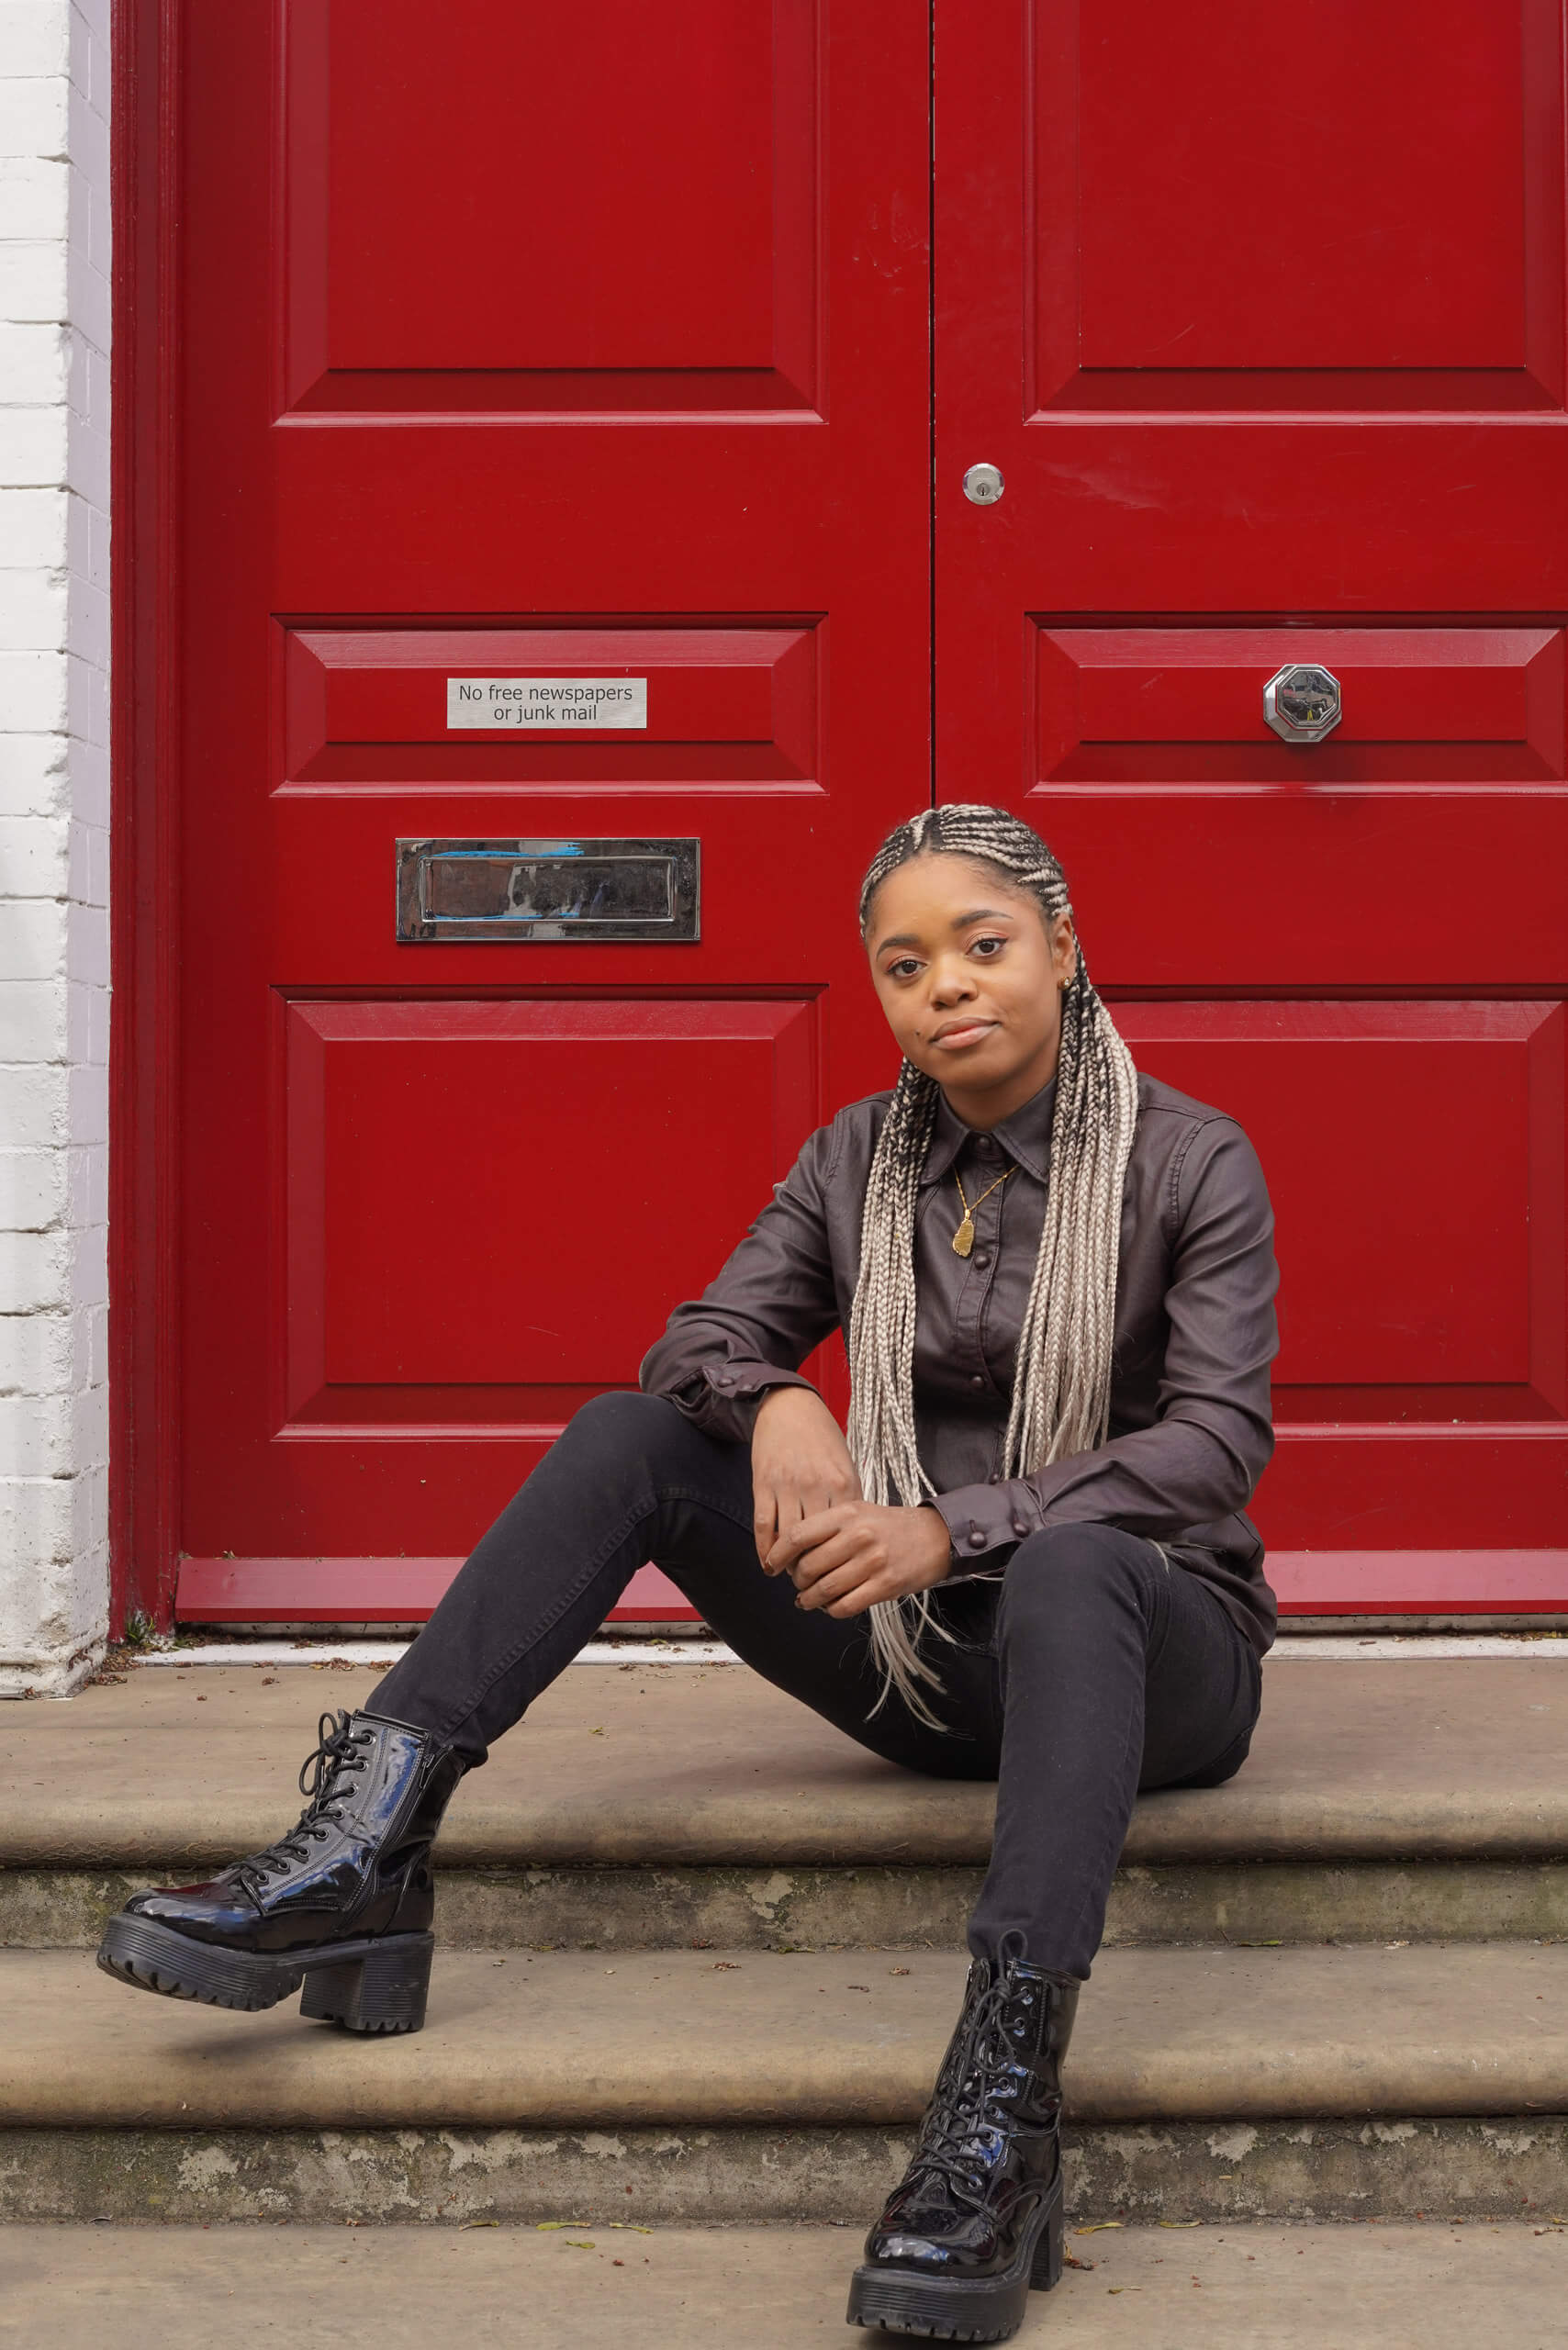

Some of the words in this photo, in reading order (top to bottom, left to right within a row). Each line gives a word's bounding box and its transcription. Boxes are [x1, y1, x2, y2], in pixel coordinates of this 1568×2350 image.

[459, 685, 483, 700] No
[488, 684, 523, 700] free
[529, 688, 633, 704] newspapers
[493, 707, 511, 721] or
[516, 704, 556, 723] junk
[561, 704, 597, 721] mail
